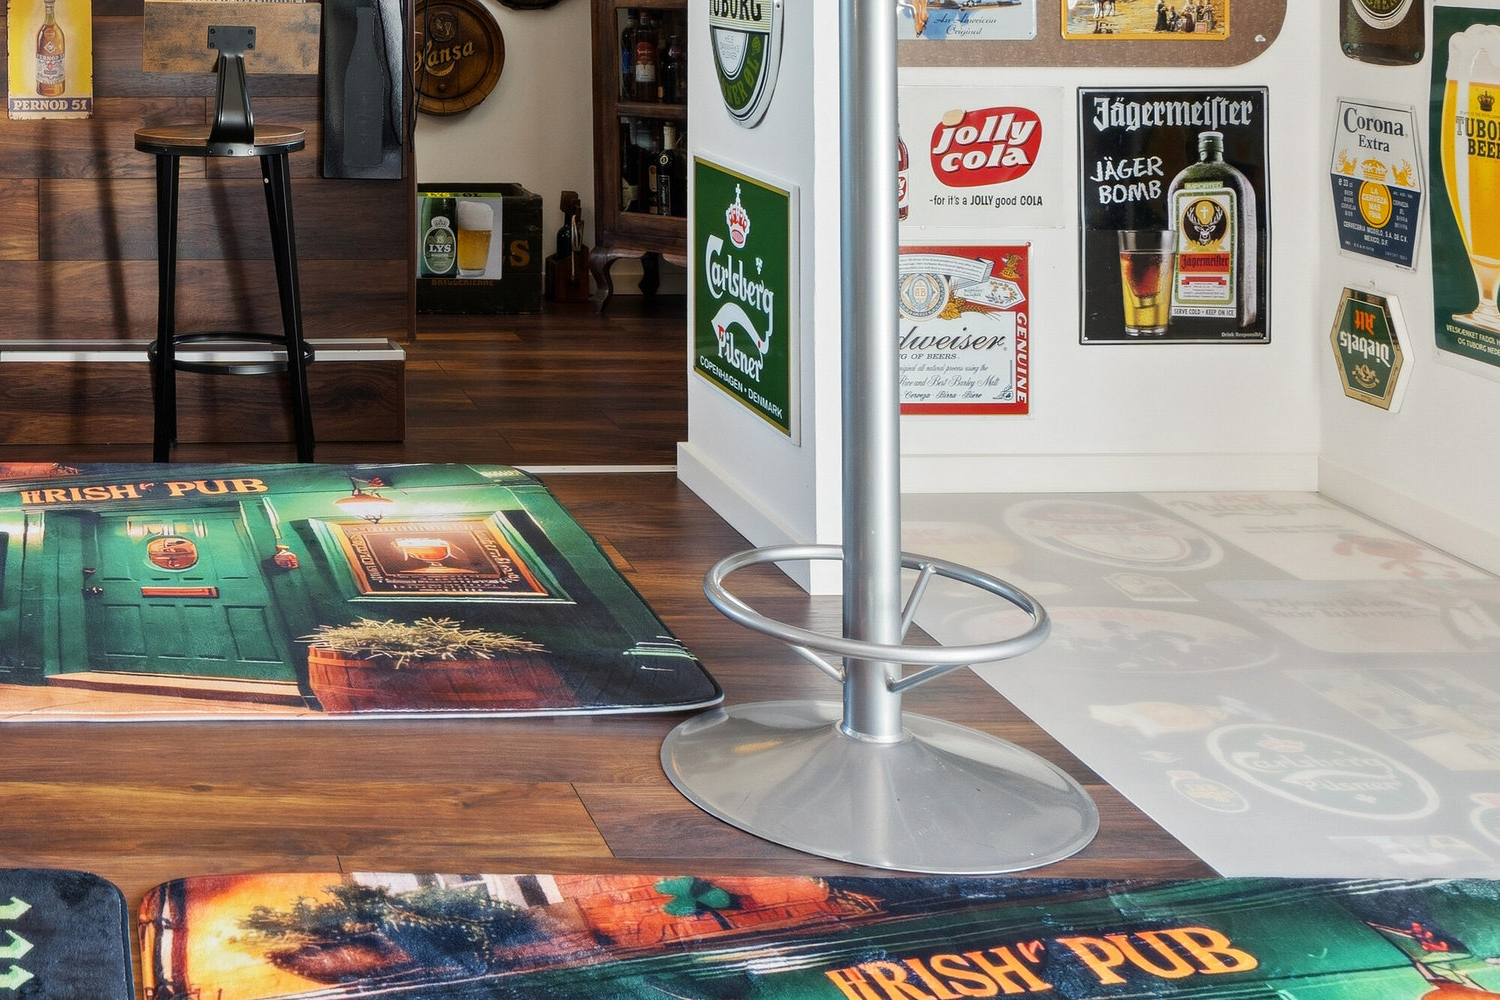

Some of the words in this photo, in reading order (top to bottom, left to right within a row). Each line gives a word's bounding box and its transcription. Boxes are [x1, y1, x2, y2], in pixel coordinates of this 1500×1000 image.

[946, 26, 983, 36] Original
[956, 15, 997, 25] American
[414, 39, 477, 77] Hansa
[12, 100, 69, 112] PERNOD
[70, 100, 88, 112] 51
[1092, 95, 1255, 131] Jägermeister
[932, 112, 1039, 155] jolly
[1343, 107, 1405, 137] Corona
[1357, 133, 1391, 153] Extra
[940, 143, 1032, 173] cola
[1090, 155, 1165, 184] JÄGER
[948, 195, 960, 206] it's
[970, 195, 994, 206] JOLLY
[995, 195, 1017, 208] good
[1020, 195, 1043, 206] COLA
[1097, 179, 1163, 205] BOMB
[427, 243, 452, 254] LYS
[1181, 254, 1230, 269] Jägermeister
[704, 234, 775, 340] Carlsberg
[1173, 308, 1188, 316] SERVE
[1189, 308, 1201, 316] COLD
[1226, 309, 1235, 317] ICE
[1354, 308, 1377, 333] Alt
[717, 323, 764, 384] Pilsner
[1015, 311, 1028, 405] GENUINE
[1339, 331, 1391, 369] Diebels
[1466, 338, 1487, 352] TUBORG
[699, 354, 743, 393] COPENHAGEN
[747, 386, 783, 420] DENMARK
[166, 477, 269, 499] PUB
[1055, 928, 1259, 986] PUB
